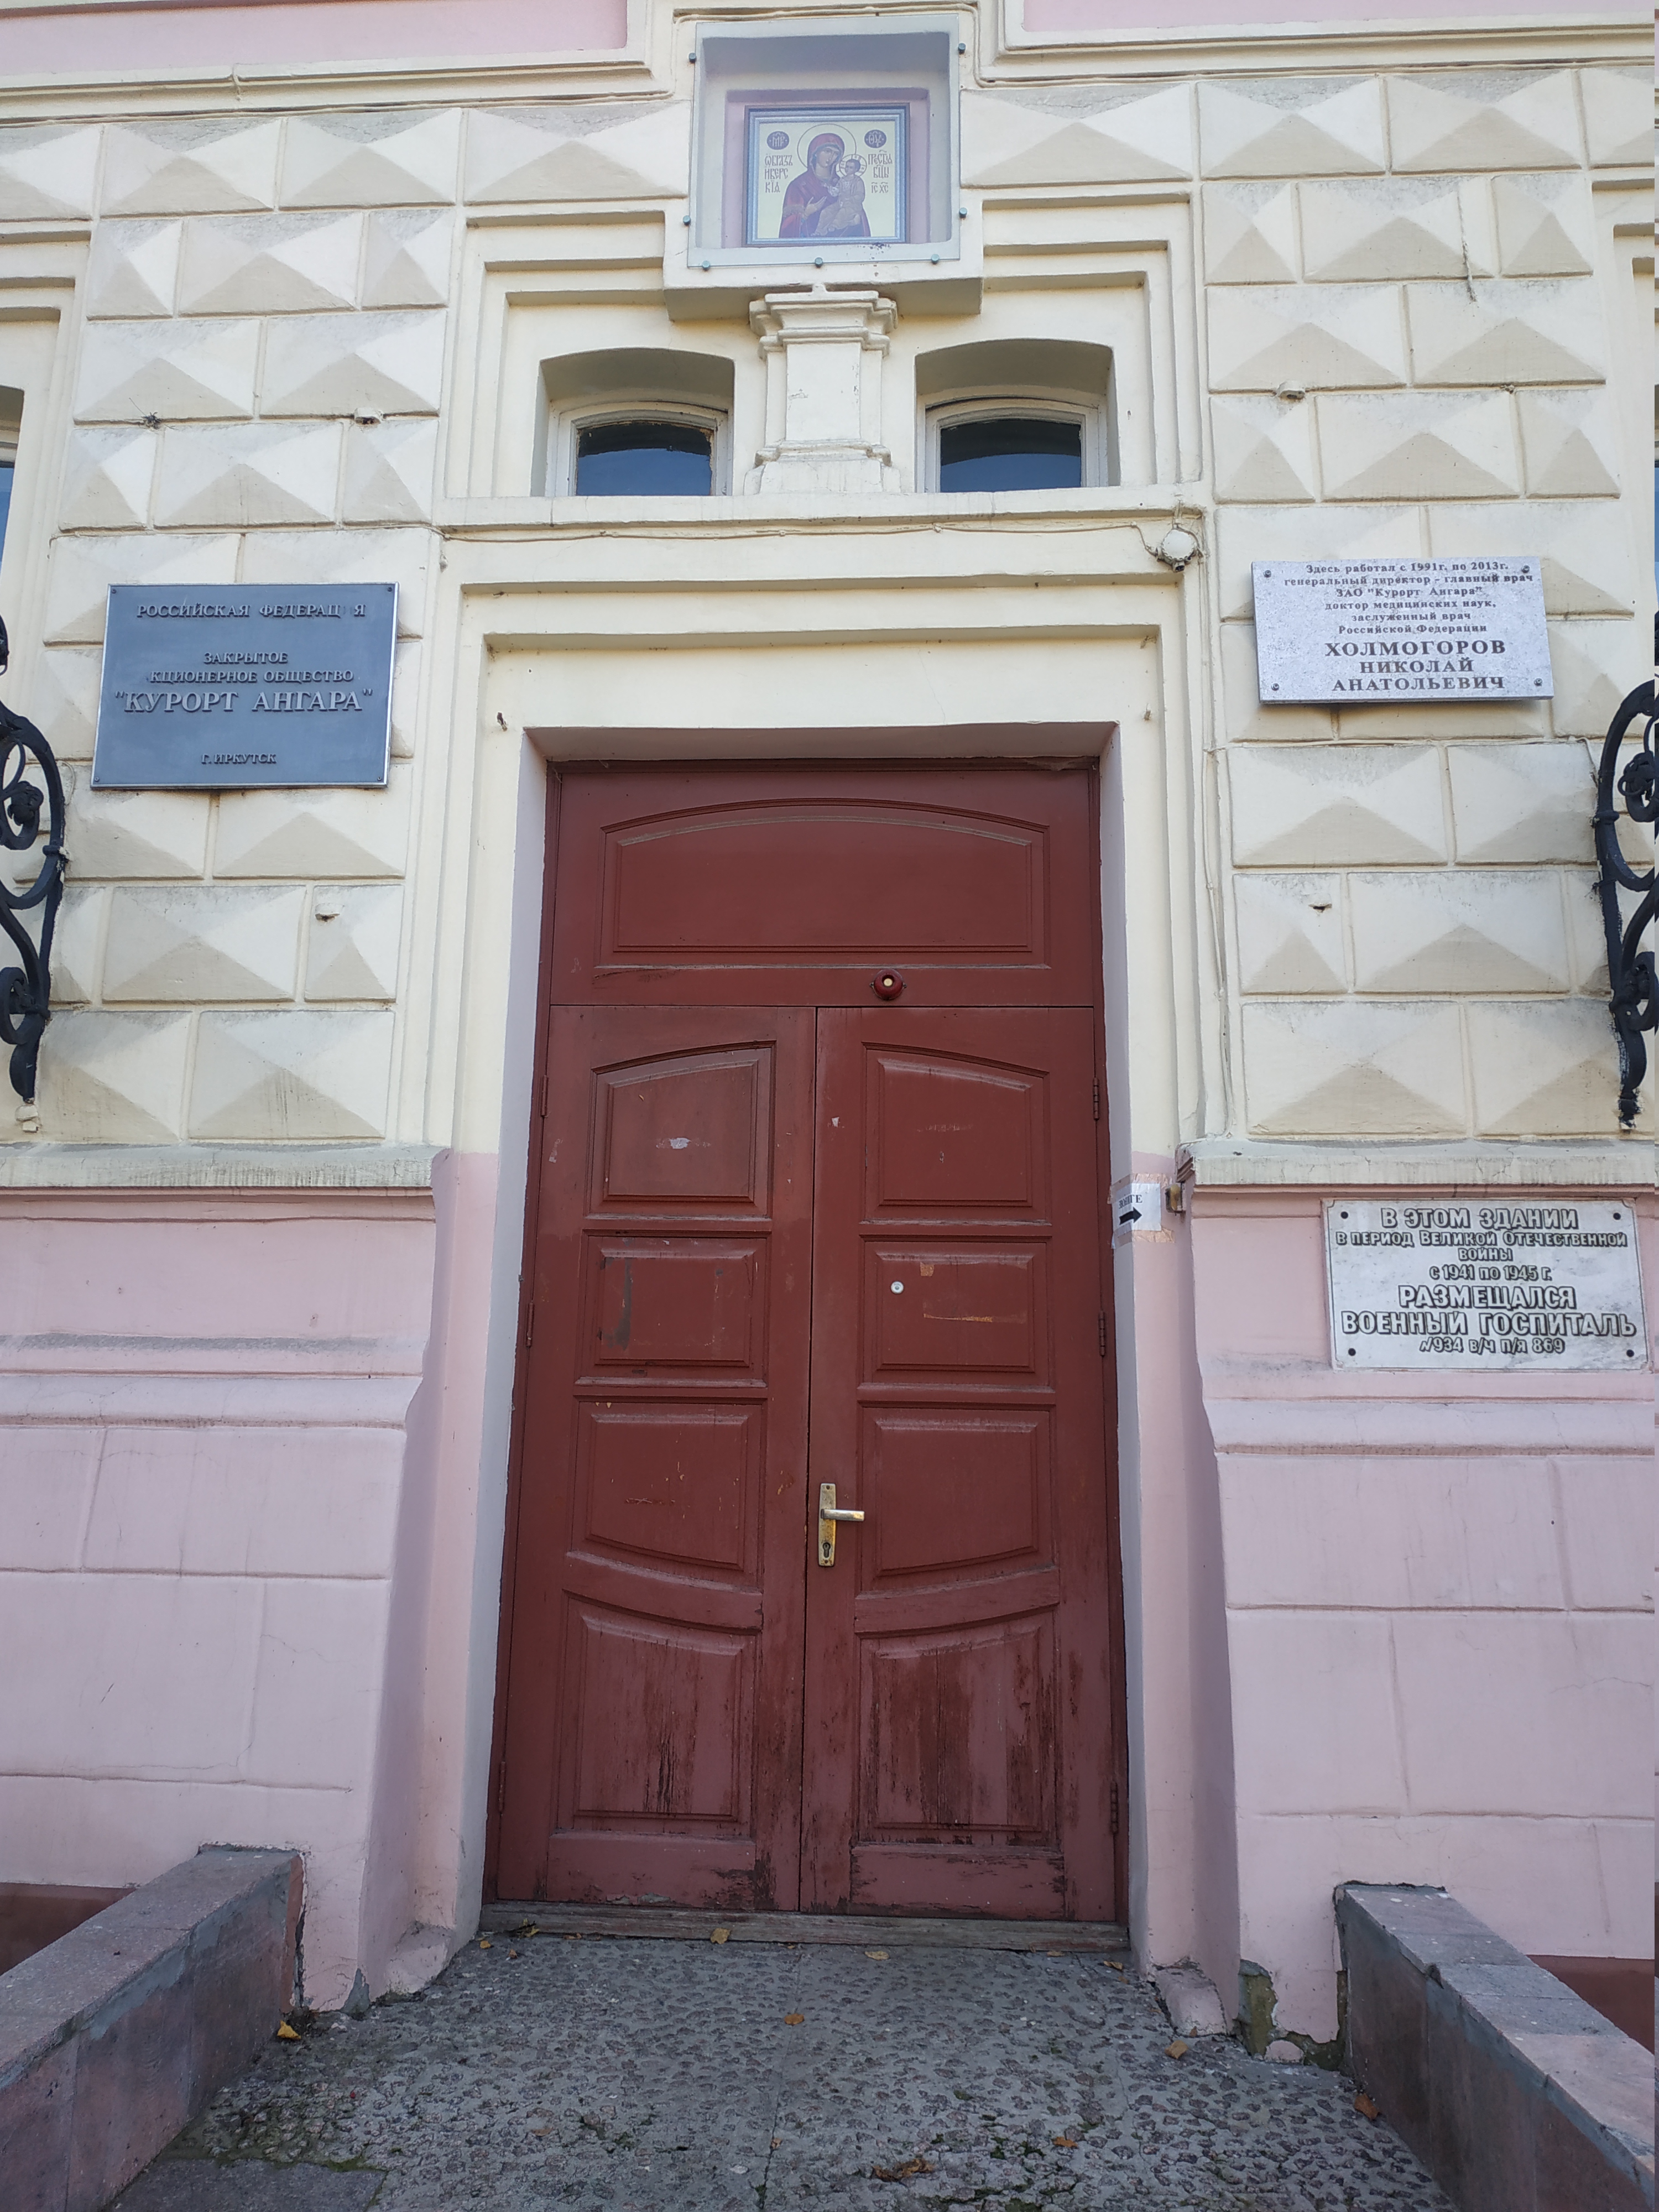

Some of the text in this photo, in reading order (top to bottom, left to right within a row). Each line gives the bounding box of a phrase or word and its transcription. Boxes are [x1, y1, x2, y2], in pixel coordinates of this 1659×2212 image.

[1306, 565, 1340, 574] Здесь
[1345, 564, 1395, 574] работал
[1411, 562, 1447, 571] 1991г.
[1470, 562, 1509, 570] 2013г.
[1284, 576, 1367, 587] генеральный
[1372, 577, 1431, 585] директор
[1444, 573, 1499, 583] главный
[1504, 575, 1533, 583] врач
[1336, 588, 1363, 597] ЗАО
[137, 603, 251, 618] РОССИЙСКАЯ
[1325, 602, 1369, 611] доктор
[1374, 601, 1458, 609] медицинских
[1352, 612, 1471, 623] заслуженный врач
[1339, 624, 1488, 634] Российской Федерации
[1324, 640, 1506, 657] ХОЛМОГОРОВ
[203, 651, 288, 664] ЗАКРЫТОЕ
[1359, 656, 1474, 674] НИКОЛАЙ
[264, 670, 354, 684] ОБЩЕСТВО
[1331, 676, 1505, 691] АНАТОЛЬЕВИЧ
[114, 688, 373, 713] "КУРОРТ АНГАРА"
[1380, 1208, 1579, 1230] В ЭТОМ ЗДАНИИ
[1350, 1231, 1415, 1248] ПЕРИОД
[1458, 1247, 1514, 1261] ВОЙНЫ
[1441, 1264, 1475, 1280] 1941
[1503, 1265, 1539, 1281] 1945
[1397, 1284, 1578, 1311] РАЗМЕЩАЛСЯ
[1340, 1310, 1637, 1337] ВОЕННЫЙ ГОСПИТАЛЬ
[1531, 1337, 1566, 1354] 869
